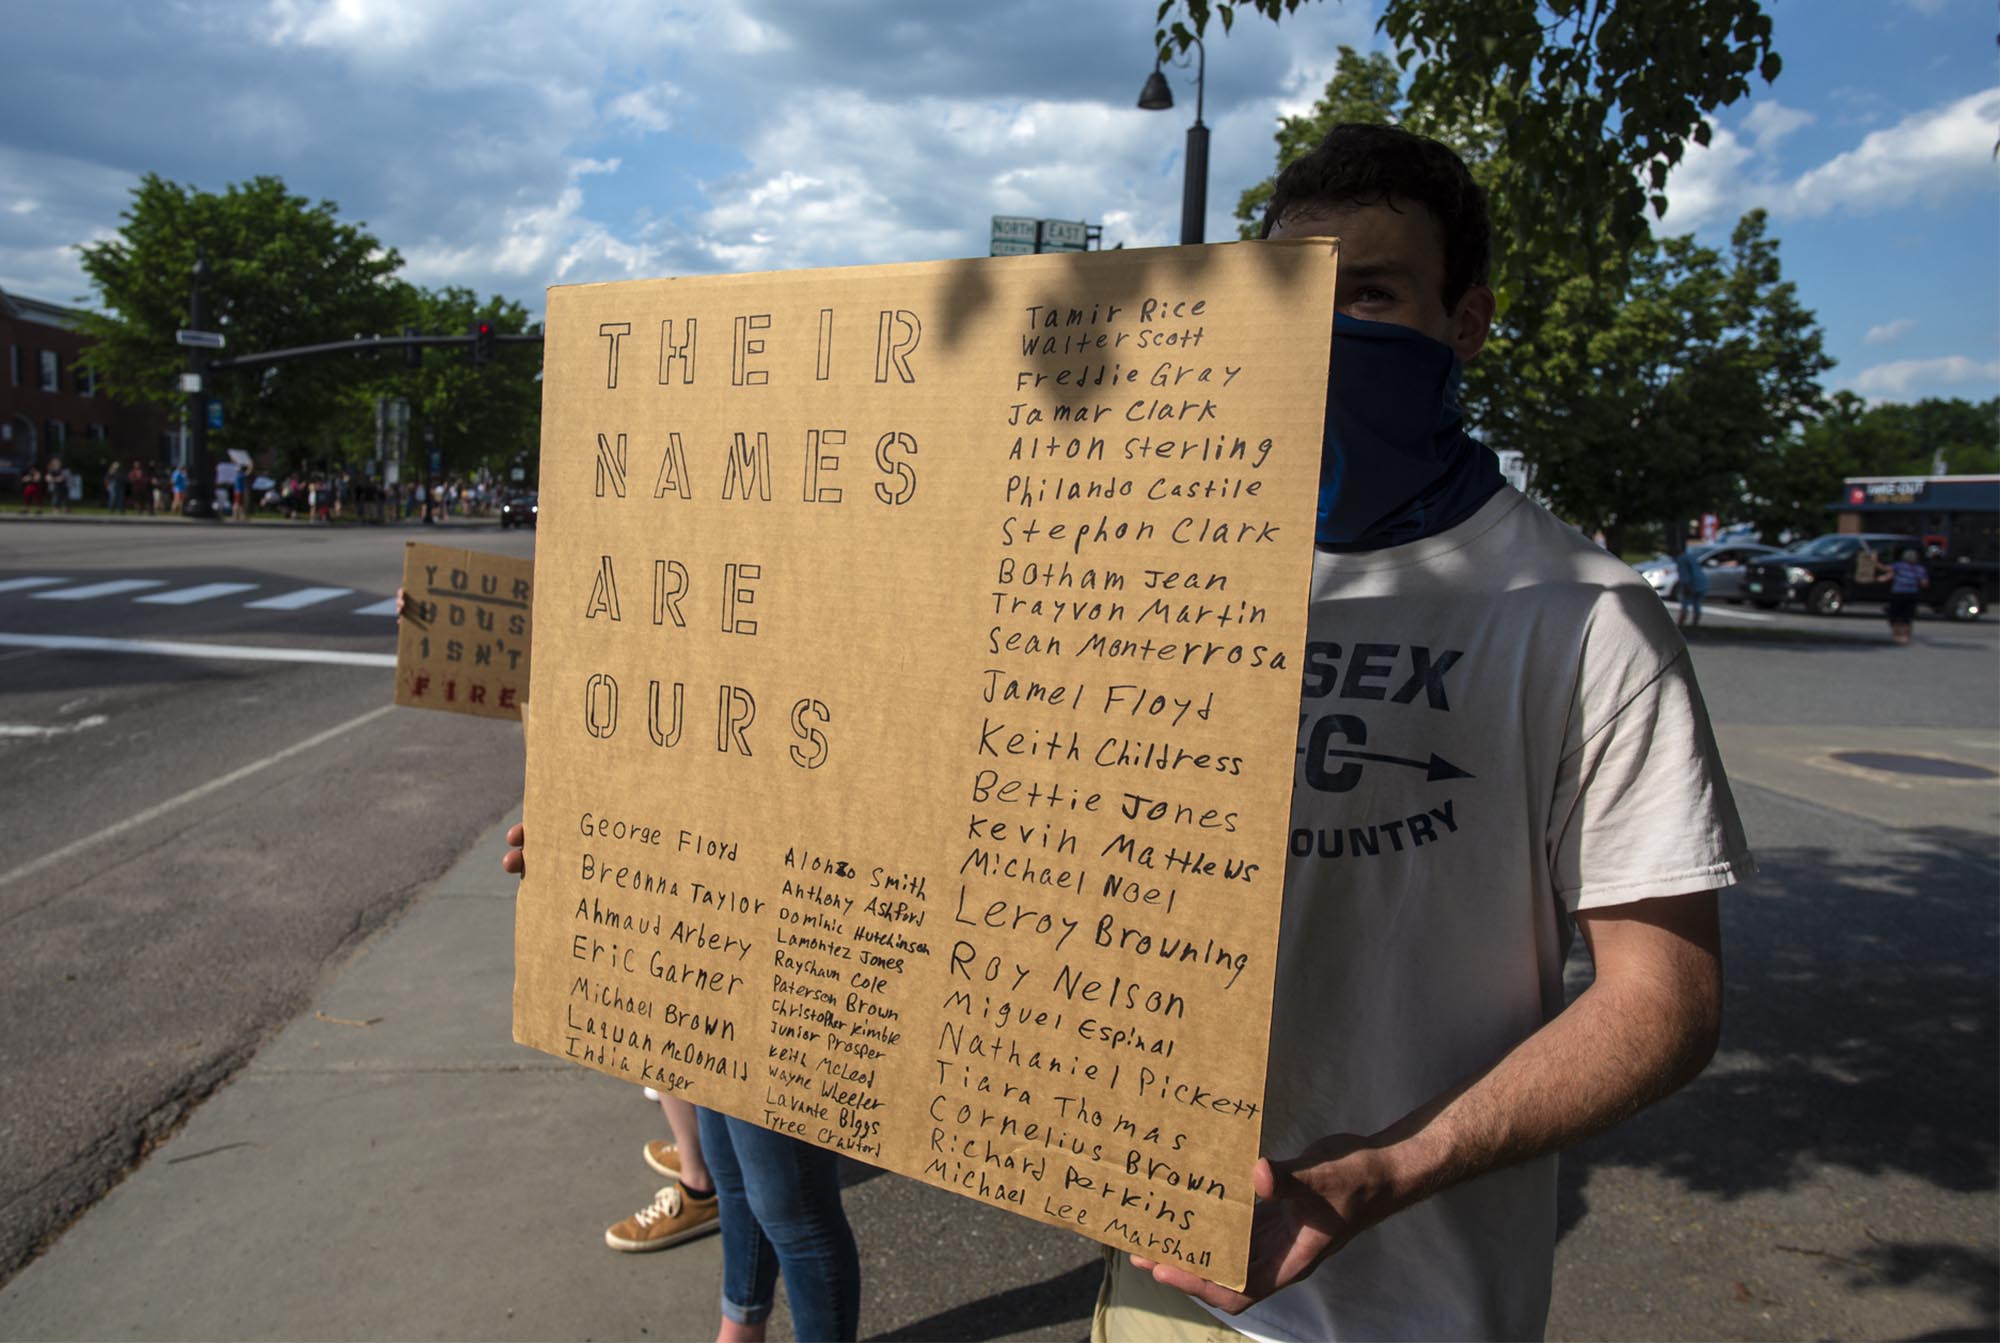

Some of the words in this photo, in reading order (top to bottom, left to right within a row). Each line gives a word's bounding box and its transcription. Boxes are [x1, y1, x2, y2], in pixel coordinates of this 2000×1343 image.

[1049, 222, 1080, 238] EAST
[1026, 305, 1122, 329] Tamir
[1140, 298, 1206, 323] Rice
[599, 308, 922, 389] THEIR
[1022, 330, 1131, 357] Walter
[1137, 326, 1205, 349] Scott
[1016, 363, 1139, 391] Freddie
[1150, 362, 1241, 387] Gray
[1008, 403, 1112, 426] Jamar
[1125, 400, 1217, 423] Clark
[595, 429, 918, 506] NAMES
[1009, 436, 1105, 461] Alton
[1124, 434, 1273, 469] Sterling
[1006, 475, 1133, 508] Philando
[1147, 477, 1263, 501] Castile
[1002, 515, 1154, 555] Stephon
[1171, 517, 1281, 544] Clark
[425, 565, 530, 600] YOUR
[586, 555, 761, 635] ARE
[998, 557, 1125, 591] Botham
[1144, 569, 1228, 591] Jean
[418, 601, 526, 635] HOUS
[991, 592, 1125, 623] Trayvon
[1137, 598, 1267, 628] Martin
[419, 636, 522, 670] ISN'T
[989, 626, 1062, 657] Sean
[1075, 633, 1287, 670] Monterrosa
[411, 676, 517, 709] FIRE
[983, 669, 1084, 710] Jamel
[1103, 684, 1214, 727] Floyd
[1302, 641, 1464, 712] SEX
[585, 673, 831, 769] OURS
[978, 717, 1080, 761] Keith
[1094, 737, 1243, 776] Childress
[1294, 714, 1368, 793] C
[972, 770, 1102, 812] Bettie
[1121, 792, 1239, 833] Jones
[580, 812, 661, 846] George
[678, 829, 738, 861] Floyd
[968, 814, 1076, 854] Kevin
[1101, 834, 1260, 882] Matthews
[1291, 799, 1458, 858] OUNTRY
[582, 853, 679, 897] Breonna
[691, 882, 766, 914] Taylor
[784, 847, 856, 879] Alonzo
[870, 867, 926, 901] Smith
[960, 848, 1085, 895] Michael
[1103, 874, 1176, 914] Noel
[782, 879, 854, 916] Anthony
[863, 896, 925, 927] Ashford
[575, 897, 661, 936] Ahmaud
[670, 920, 752, 961] Arbery
[777, 927, 852, 960] Lamontez
[859, 950, 905, 974] Jones
[779, 907, 843, 935] Dominic
[853, 926, 930, 956] Hutchinson
[955, 885, 1078, 951] Leroy
[1095, 914, 1249, 990] Browning
[573, 935, 635, 973] Eric
[650, 950, 744, 995] Garner
[850, 972, 888, 994] Cole
[951, 940, 1030, 991] Roy
[1053, 965, 1185, 1019] Nelson
[570, 976, 653, 1018] Michael
[664, 1003, 735, 1041] Brown
[772, 999, 848, 1030] Christopher
[850, 1019, 901, 1046] Kimble
[773, 974, 837, 1007] Paterson
[846, 992, 899, 1021] Brown
[568, 1003, 652, 1052] Laquan
[661, 1040, 748, 1082] McDonald
[770, 1021, 821, 1042] Junior
[827, 1033, 887, 1059] Prosper
[943, 991, 1062, 1030] Miguel
[1078, 1018, 1174, 1058] Espinal
[565, 1036, 630, 1072] India
[640, 1058, 696, 1091] Kager
[768, 1065, 812, 1089] Wayne
[821, 1080, 887, 1110] Wheeler
[769, 1045, 807, 1068] Keith
[815, 1057, 875, 1089] McLeod
[938, 1022, 1119, 1089] Nathaniel
[1140, 1067, 1261, 1120] Pickett
[763, 1109, 807, 1136] Tyree
[839, 1107, 881, 1138] Biggs
[936, 1059, 1031, 1104] Tiara
[1054, 1096, 1187, 1150] Thomas
[929, 1095, 1102, 1162] Cornelius
[1125, 1150, 1226, 1200] Brown
[931, 1127, 1046, 1181] Richard
[1065, 1165, 1195, 1231] Perkins
[924, 1158, 1026, 1205] Michael
[1044, 1196, 1087, 1226] Lee
[1103, 1218, 1212, 1267] Marshall
